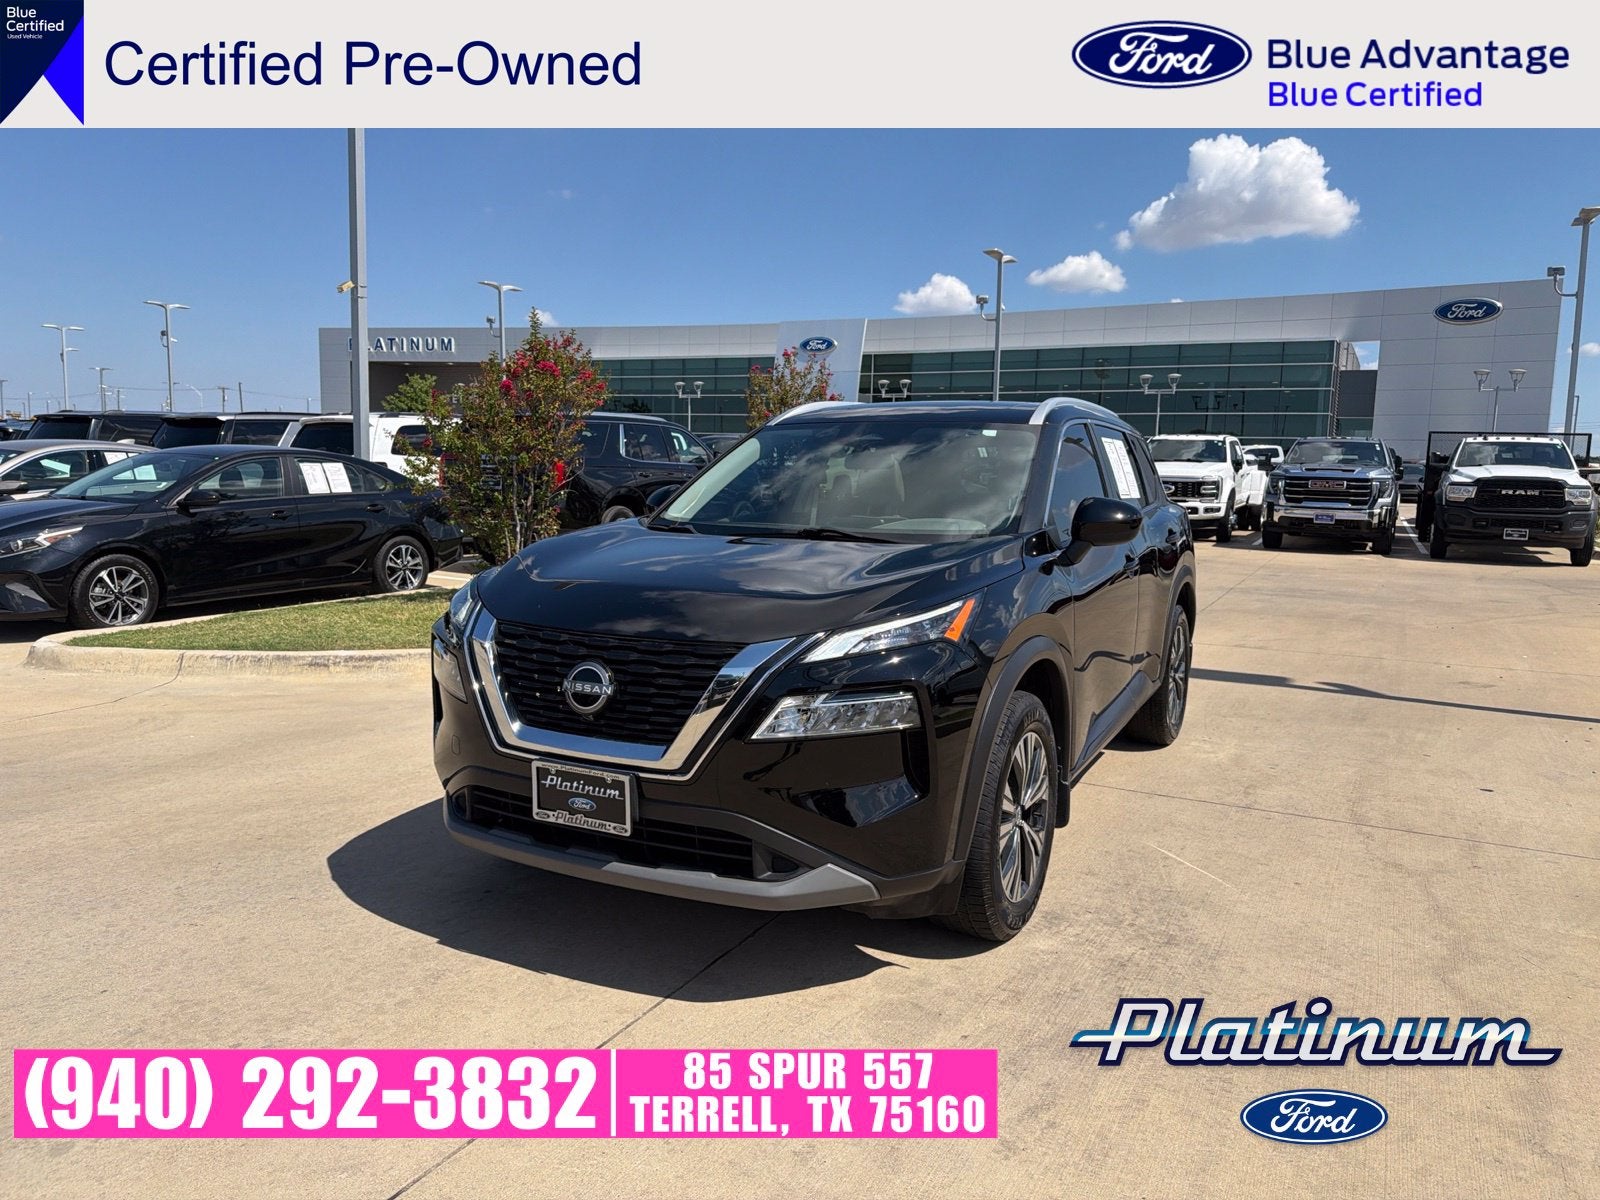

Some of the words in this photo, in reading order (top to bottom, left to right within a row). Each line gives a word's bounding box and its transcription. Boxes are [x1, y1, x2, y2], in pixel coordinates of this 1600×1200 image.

[1447, 303, 1487, 319] Ford
[347, 336, 455, 353] ATINUM
[563, 679, 612, 695] NISSAN
[541, 775, 624, 800] Platinum
[554, 811, 611, 832] Platinum
